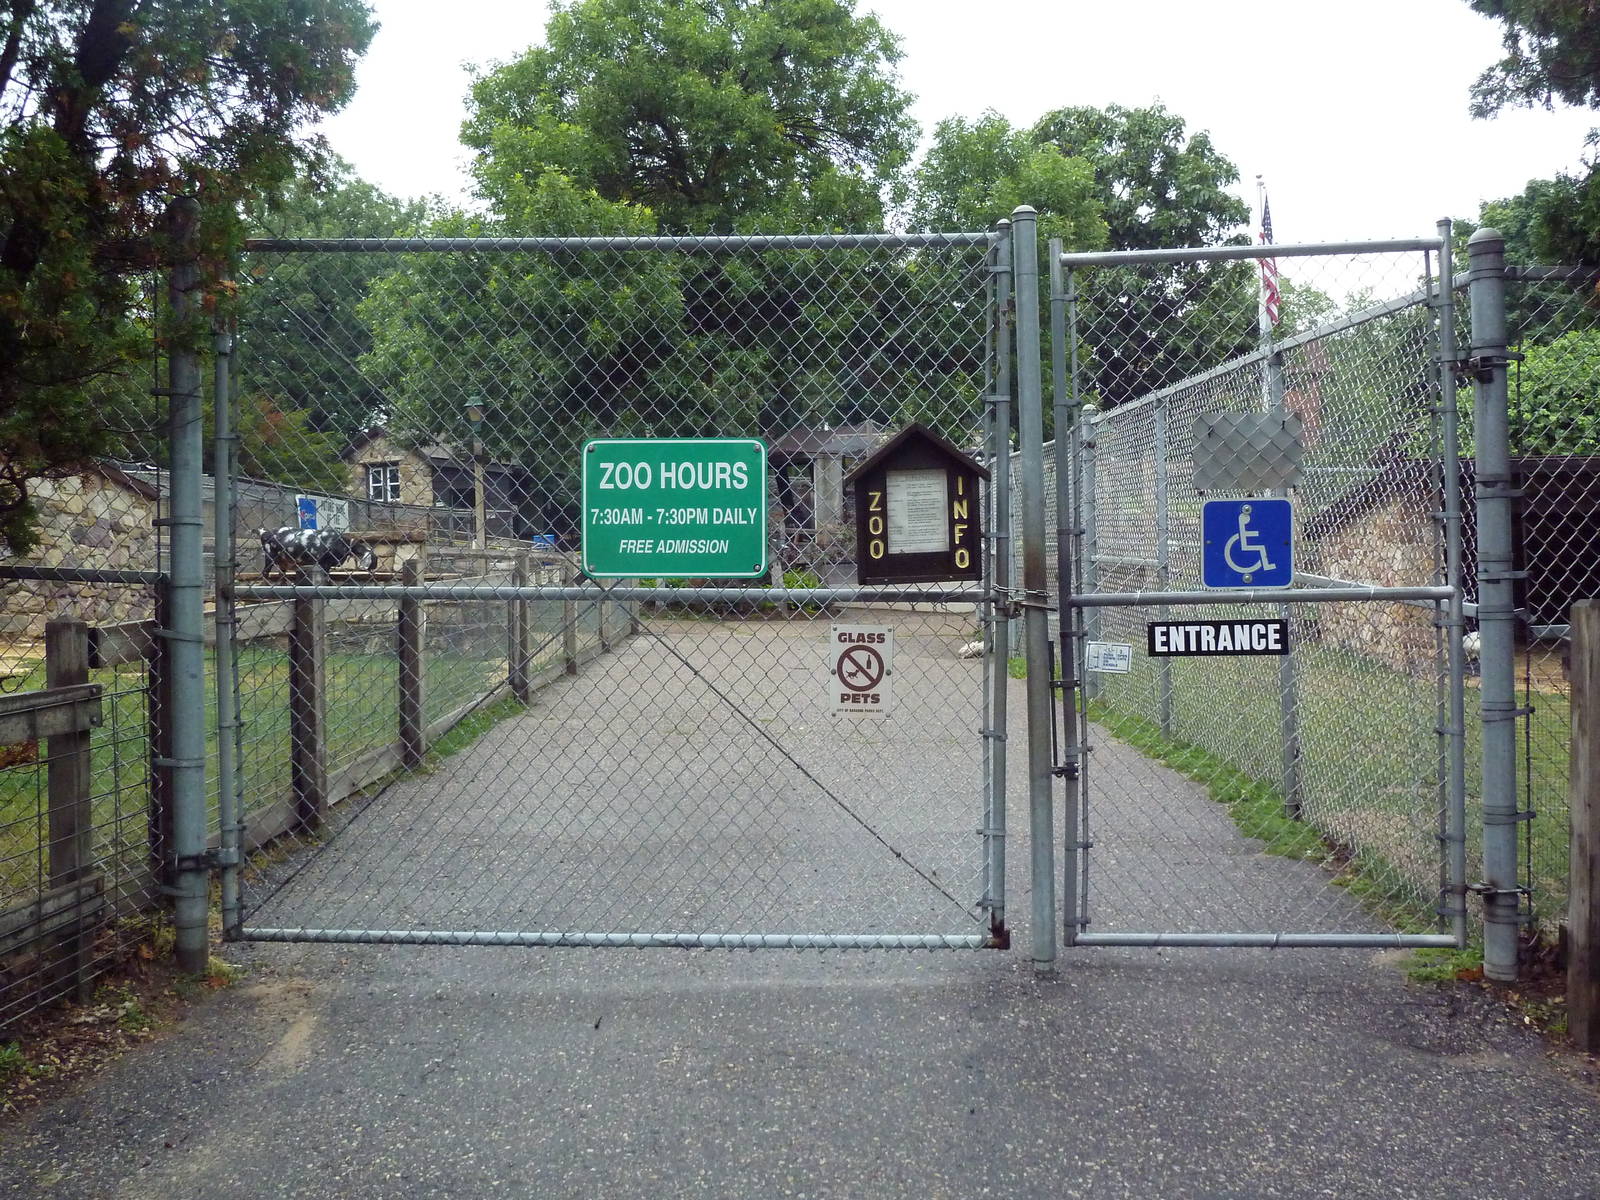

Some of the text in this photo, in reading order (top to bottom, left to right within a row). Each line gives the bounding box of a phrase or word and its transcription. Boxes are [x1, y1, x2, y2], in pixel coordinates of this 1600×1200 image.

[599, 461, 749, 490] ZOO HOURS
[590, 507, 643, 525] 7:30AM
[656, 507, 709, 525] 7:30PM
[712, 507, 757, 525] DAILY
[868, 491, 885, 560] ZOO
[953, 476, 970, 569] INFO
[619, 539, 729, 554] FREE ADMISSION
[837, 632, 886, 644] GLASS
[1154, 623, 1282, 653] ENTRANCE
[840, 693, 881, 704] PETS
